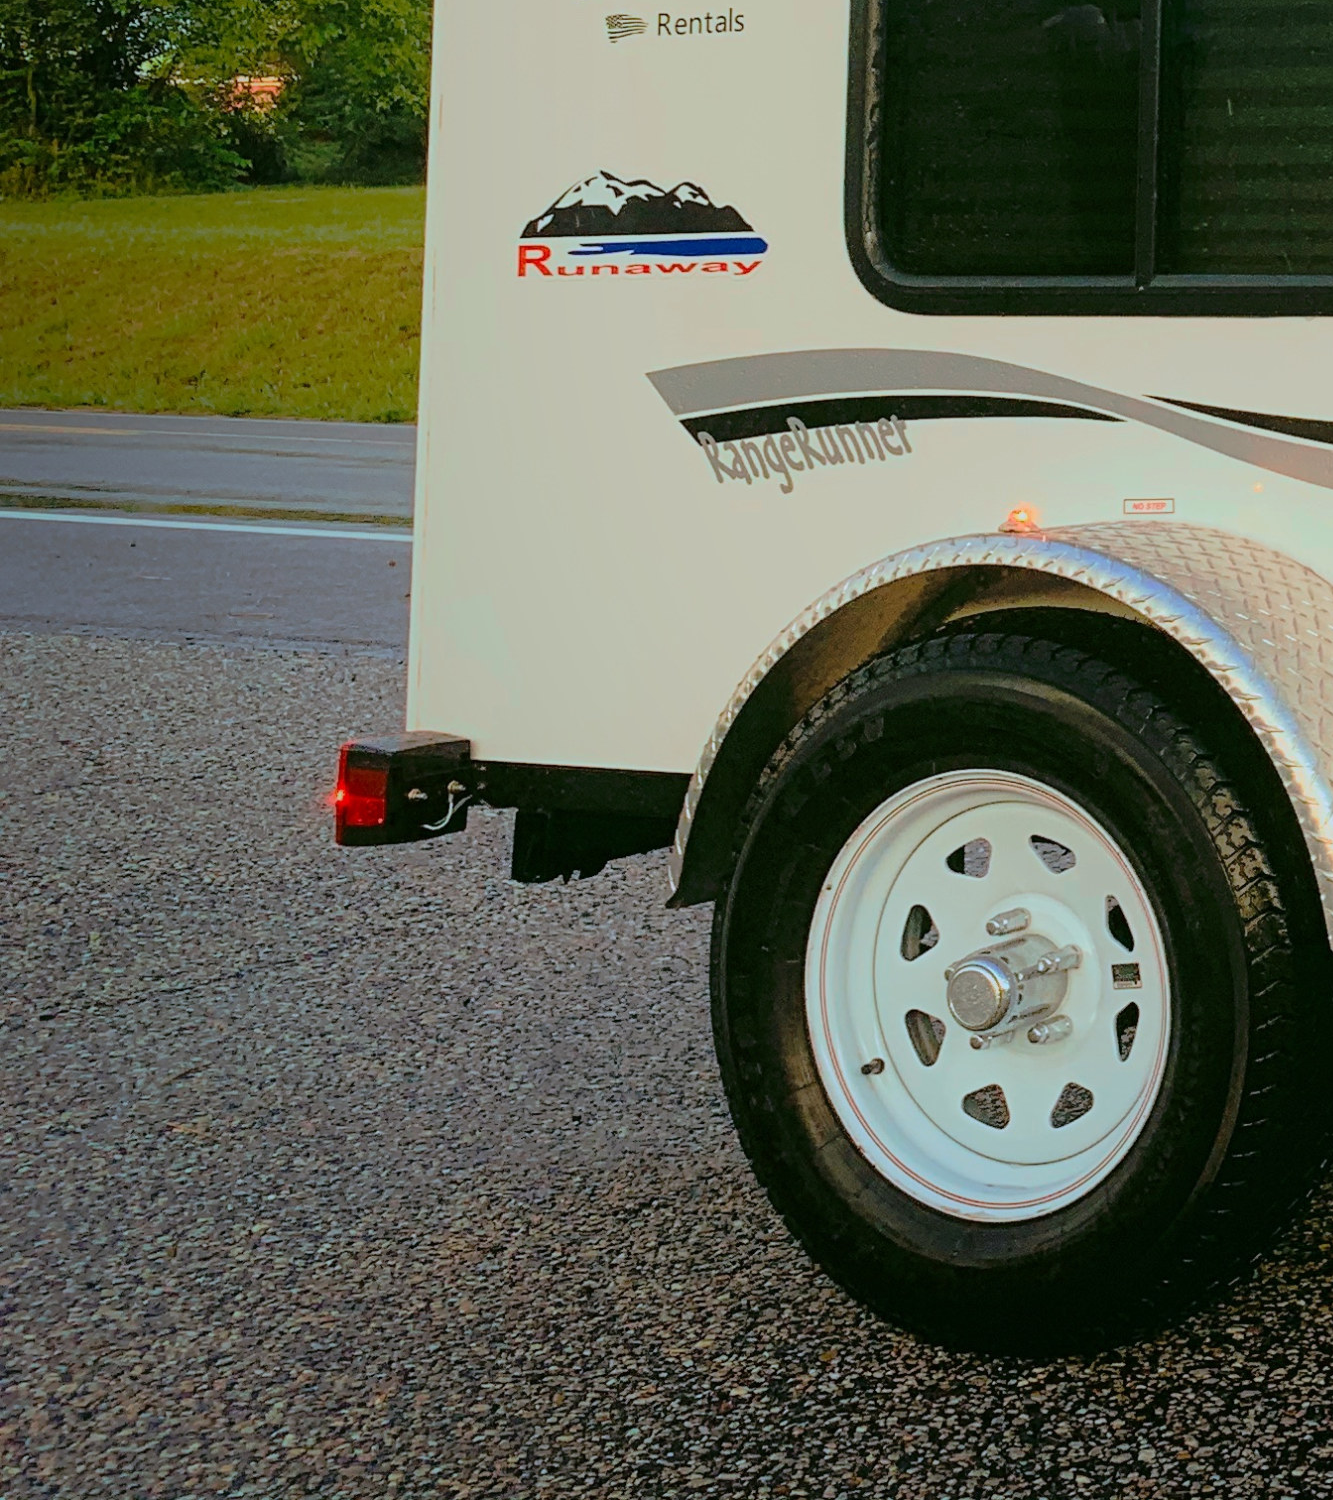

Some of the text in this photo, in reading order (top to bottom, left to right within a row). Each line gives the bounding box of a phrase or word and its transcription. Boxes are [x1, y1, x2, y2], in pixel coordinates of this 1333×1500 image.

[657, 7, 745, 36] Rentals
[517, 245, 763, 277] Runaway
[697, 414, 913, 494] RangeRunner
[1132, 502, 1166, 510] NO STEP
